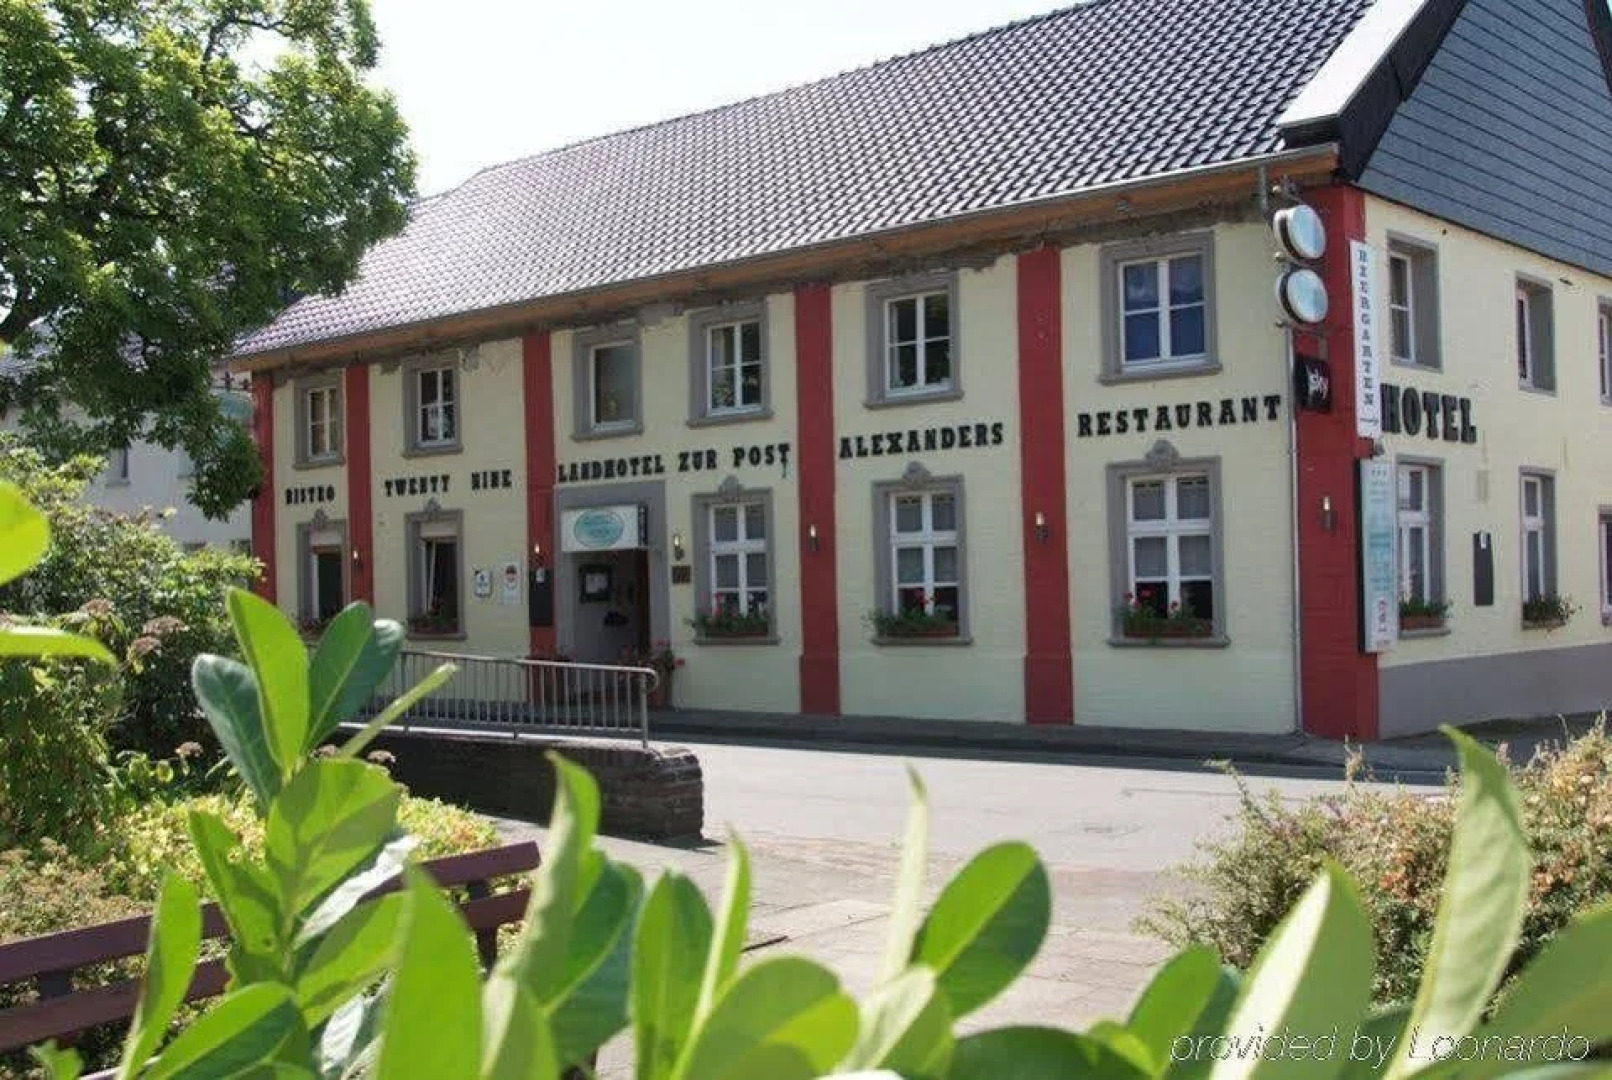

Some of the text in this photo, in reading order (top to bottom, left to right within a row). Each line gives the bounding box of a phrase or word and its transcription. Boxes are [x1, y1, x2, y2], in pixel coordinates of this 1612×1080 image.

[1358, 250, 1375, 406] BIERGARTEN
[839, 394, 1282, 459] ALEXANDERS RESTAURANT
[1380, 383, 1477, 444] HOTEL
[285, 469, 512, 505] BISTRO TWENTY NINE
[557, 443, 790, 483] LANDHOTEL ZUR POST
